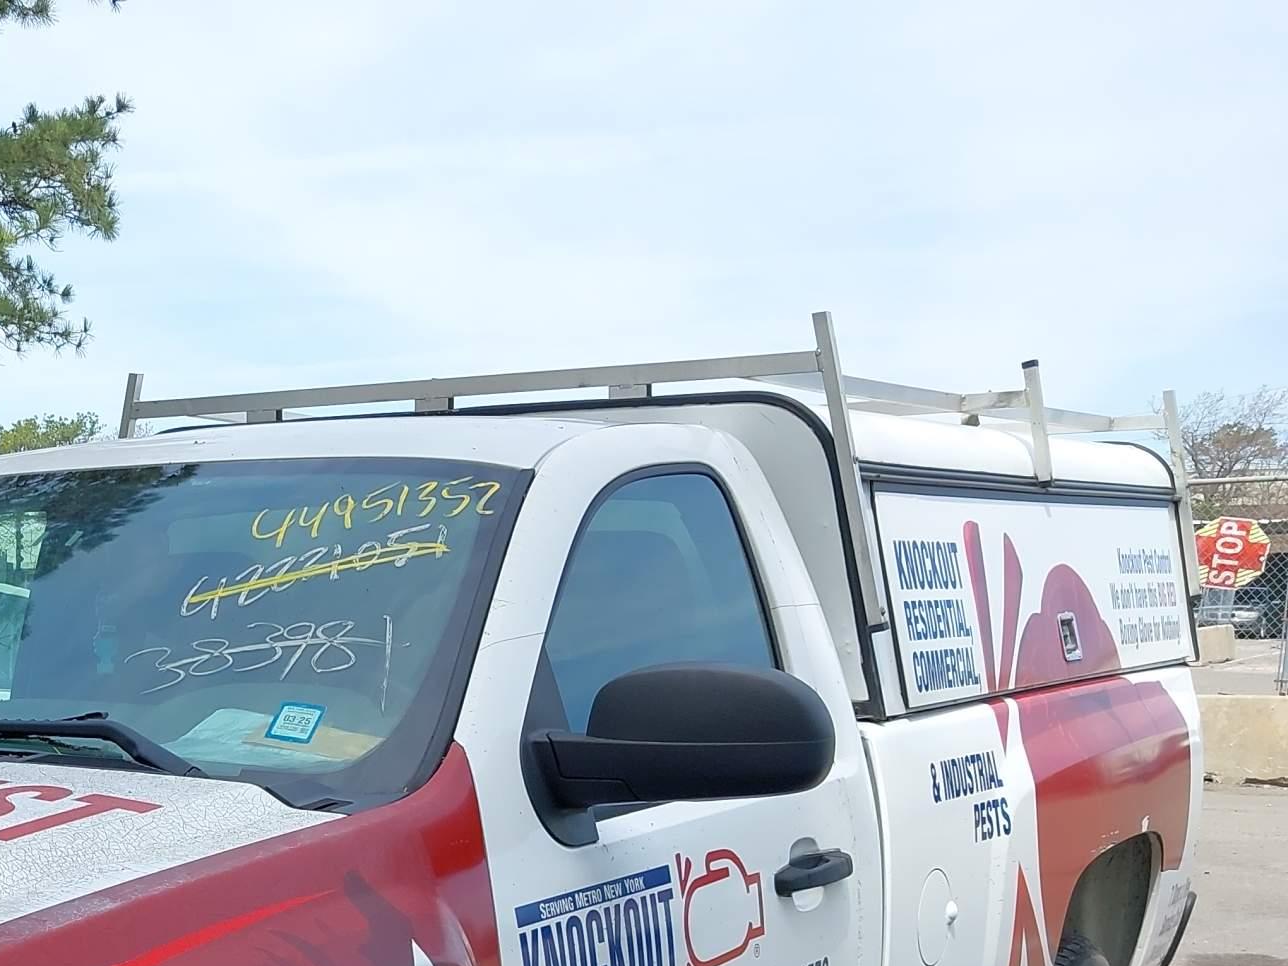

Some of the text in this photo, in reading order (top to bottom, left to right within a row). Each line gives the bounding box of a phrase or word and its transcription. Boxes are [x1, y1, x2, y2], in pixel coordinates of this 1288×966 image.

[252, 475, 501, 547] 44951352
[893, 539, 963, 590] KNOCKOUT
[1208, 521, 1247, 585] STOP
[904, 599, 974, 645] RESIDENTIAL,
[912, 647, 983, 693] COMMERCIAL,
[930, 750, 1004, 803] & INDUSTRIAL
[973, 797, 1011, 842] PESTS
[539, 876, 645, 919] SERVING METRO NEW YORK
